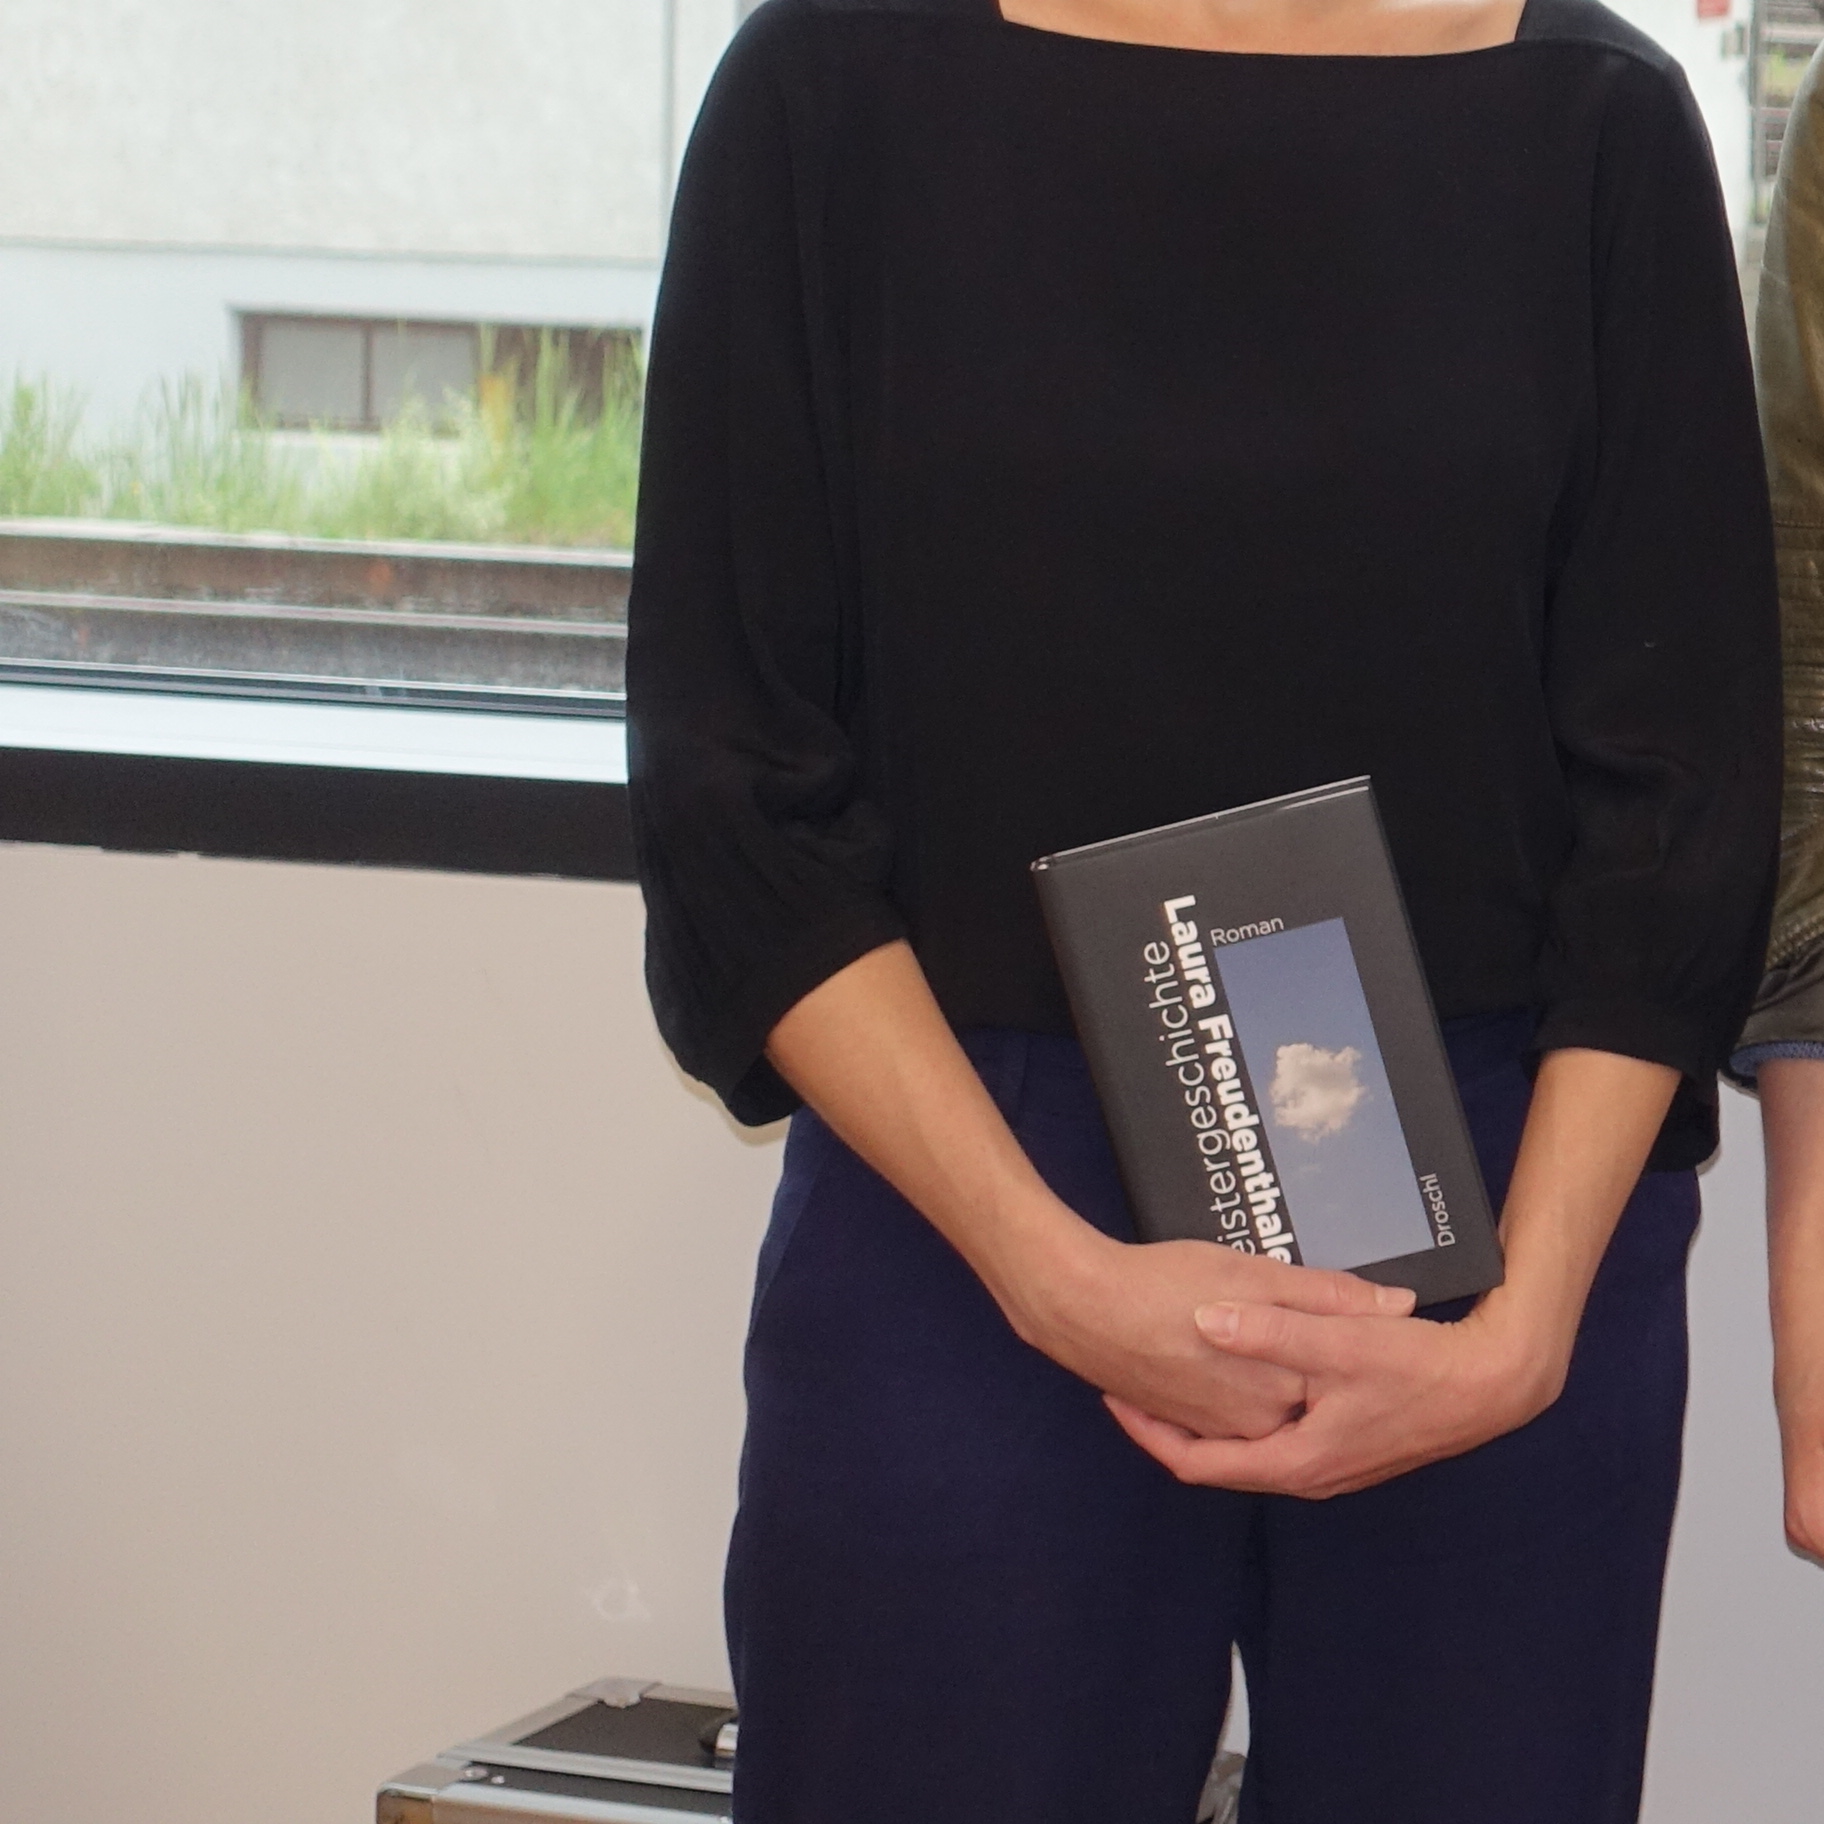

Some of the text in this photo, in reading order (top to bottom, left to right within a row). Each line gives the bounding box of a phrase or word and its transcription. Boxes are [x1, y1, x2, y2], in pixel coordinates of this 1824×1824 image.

[1210, 915, 1285, 946] Roman
[1143, 939, 1256, 1257] eistergeschichte
[1164, 895, 1293, 1265] Laura Freudenthale
[1421, 1173, 1456, 1247] Droschl
